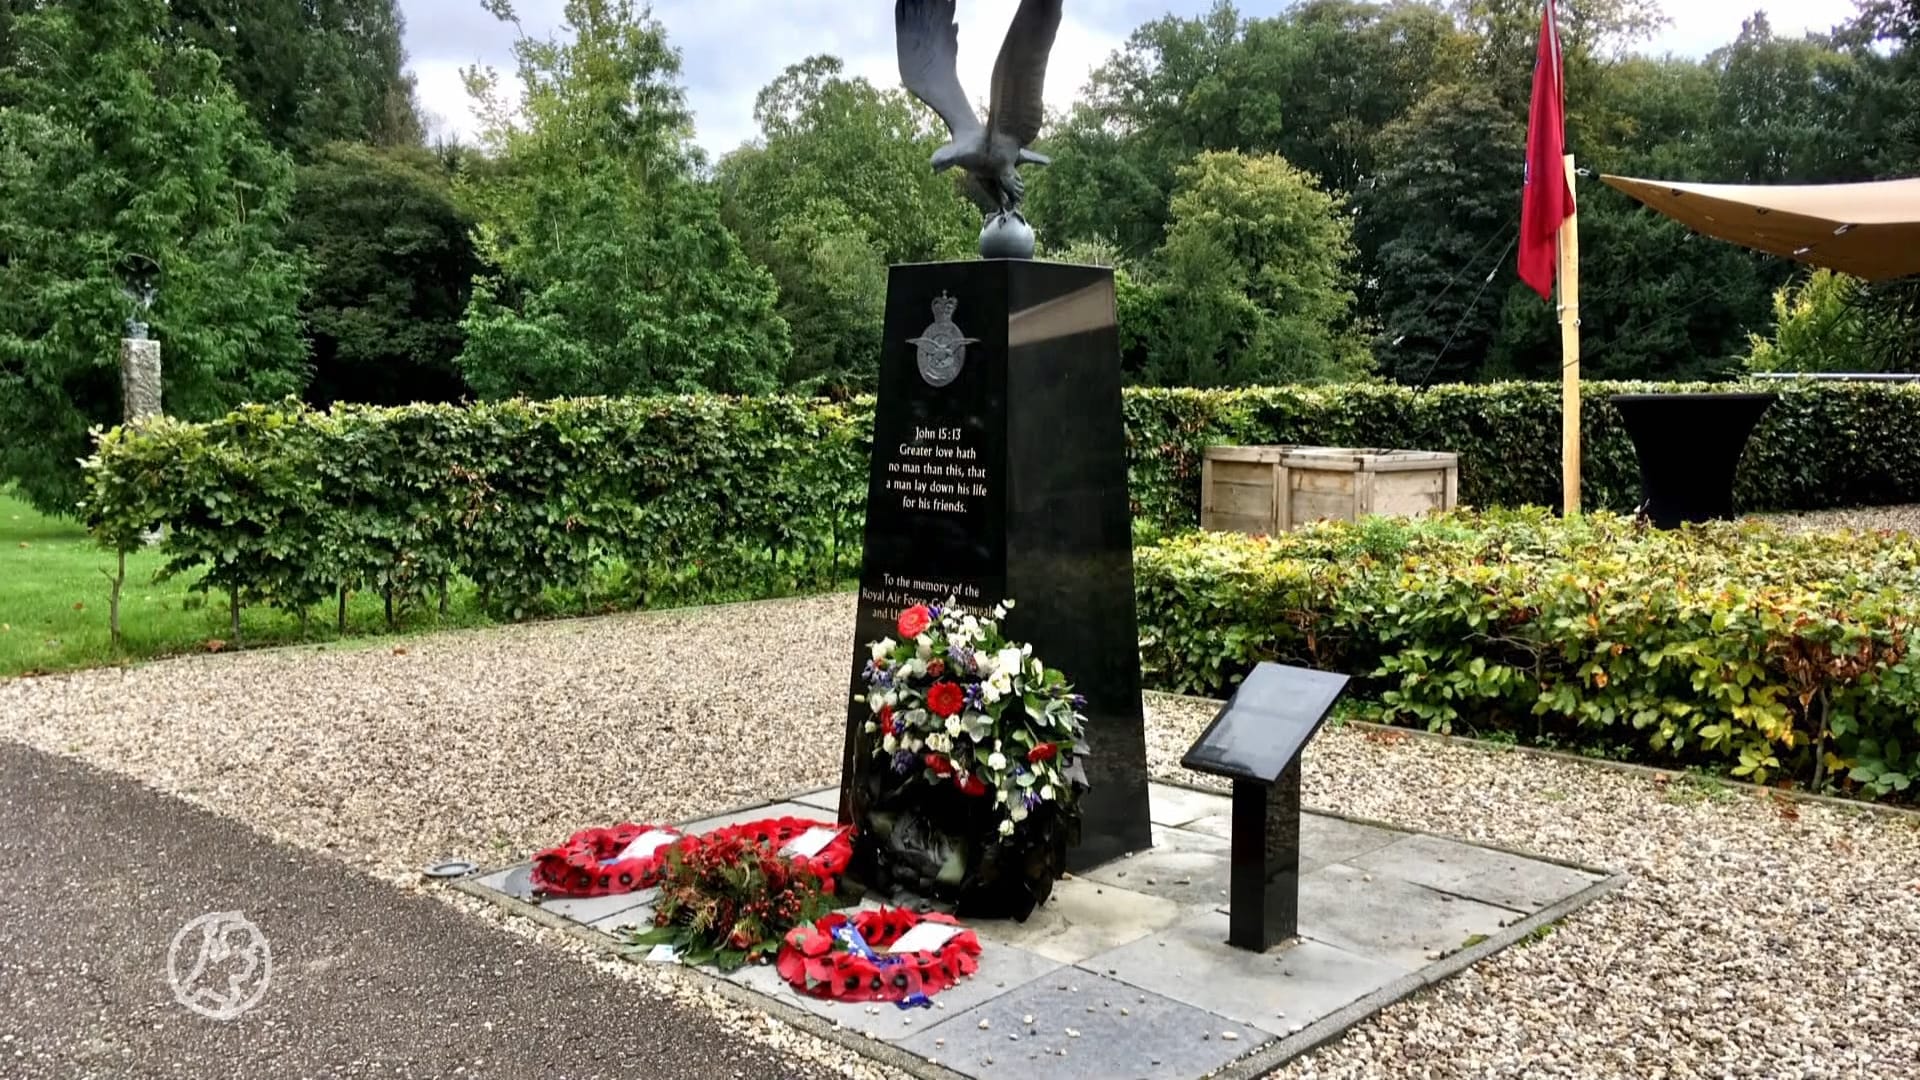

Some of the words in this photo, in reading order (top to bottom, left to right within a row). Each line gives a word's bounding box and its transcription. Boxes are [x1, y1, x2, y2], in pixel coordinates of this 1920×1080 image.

[915, 426, 936, 440] John
[938, 427, 961, 441] 15:13
[899, 443, 932, 456] Greater
[935, 445, 953, 458] love
[956, 446, 976, 460] hath
[888, 462, 900, 472] no
[902, 464, 920, 474] man
[923, 462, 943, 475] than
[946, 463, 965, 478] this,
[967, 465, 986, 478] that
[885, 480, 891, 489] a
[893, 480, 911, 490] man
[914, 479, 927, 493] lay
[929, 480, 954, 494] down
[957, 482, 970, 496] his
[972, 484, 987, 497] life
[902, 495, 916, 508] for
[918, 497, 930, 510] his
[933, 498, 967, 513] friends.
[883, 573, 894, 586] To
[896, 575, 911, 588] the
[913, 580, 950, 595] memory
[953, 583, 962, 595] of
[964, 584, 979, 598] the
[862, 587, 885, 602] Royal
[887, 591, 901, 604] Air
[931, 597, 996, 619] Coonweal
[872, 607, 888, 619] and
